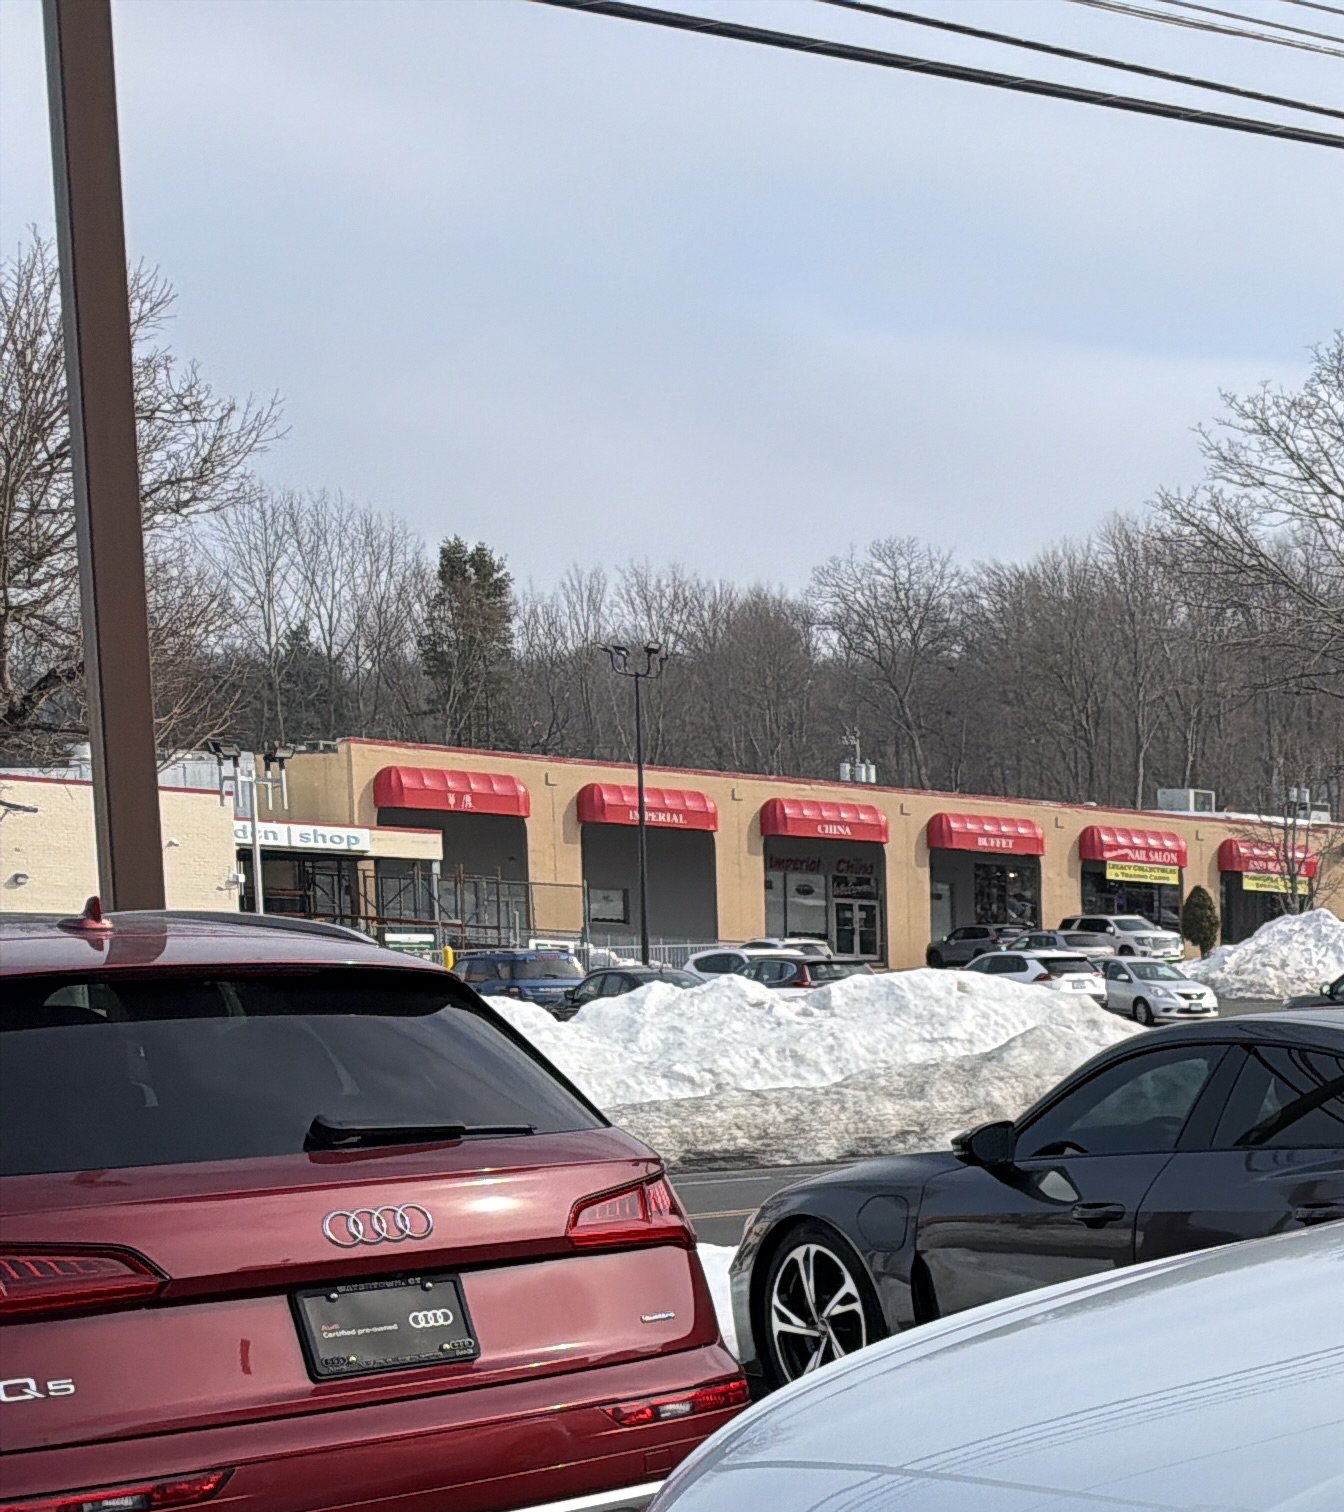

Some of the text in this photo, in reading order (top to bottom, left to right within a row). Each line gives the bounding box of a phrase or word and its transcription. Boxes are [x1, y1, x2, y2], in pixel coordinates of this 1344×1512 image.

[817, 824, 852, 836] CHINA
[298, 829, 361, 850] shop
[977, 837, 1014, 849] BUFFET
[1128, 849, 1178, 863] NAIL SALON
[322, 1323, 399, 1339] Certified pre-owned
[0, 1377, 76, 1402] Q5
